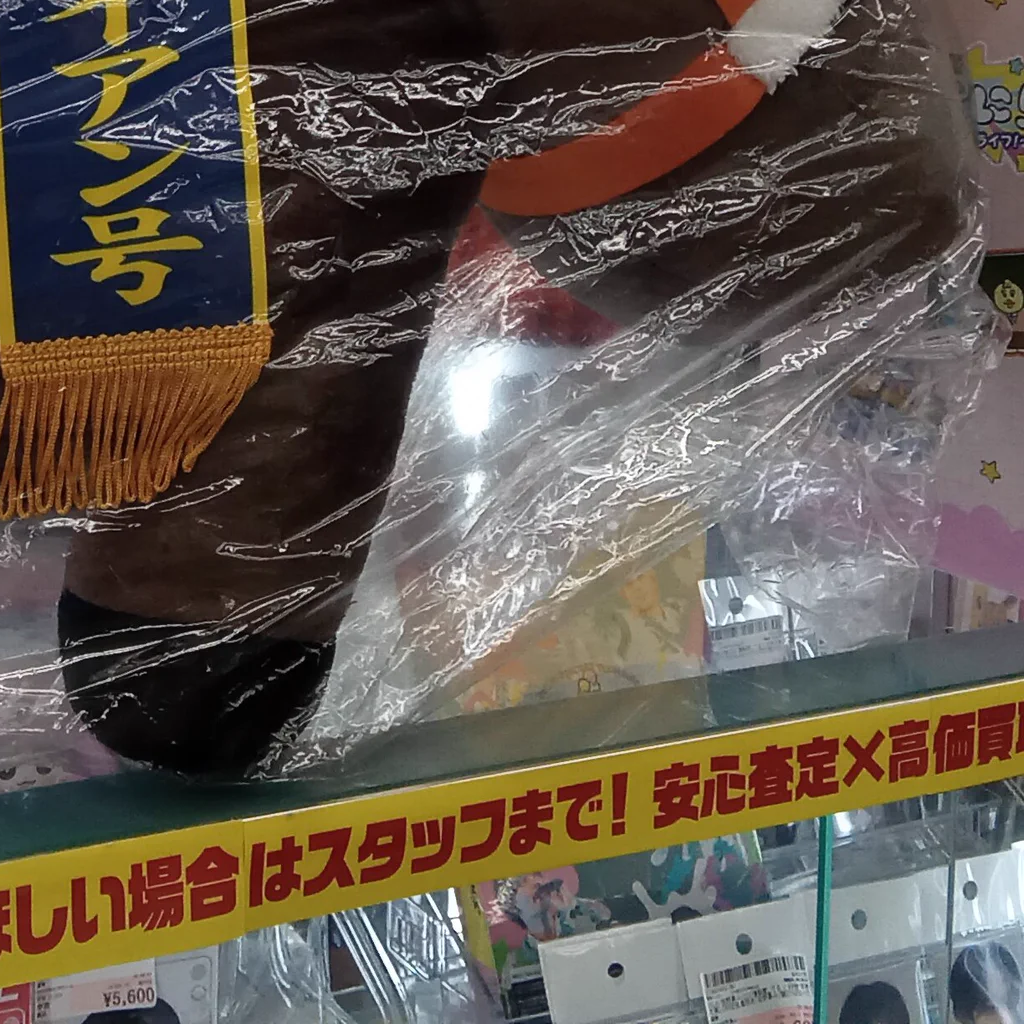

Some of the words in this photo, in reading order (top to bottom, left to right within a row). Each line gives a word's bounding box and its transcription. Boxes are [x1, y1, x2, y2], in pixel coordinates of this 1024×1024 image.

[653, 702, 1024, 830] 安心査定×高価買
[103, 986, 155, 1008] ¥5,600
